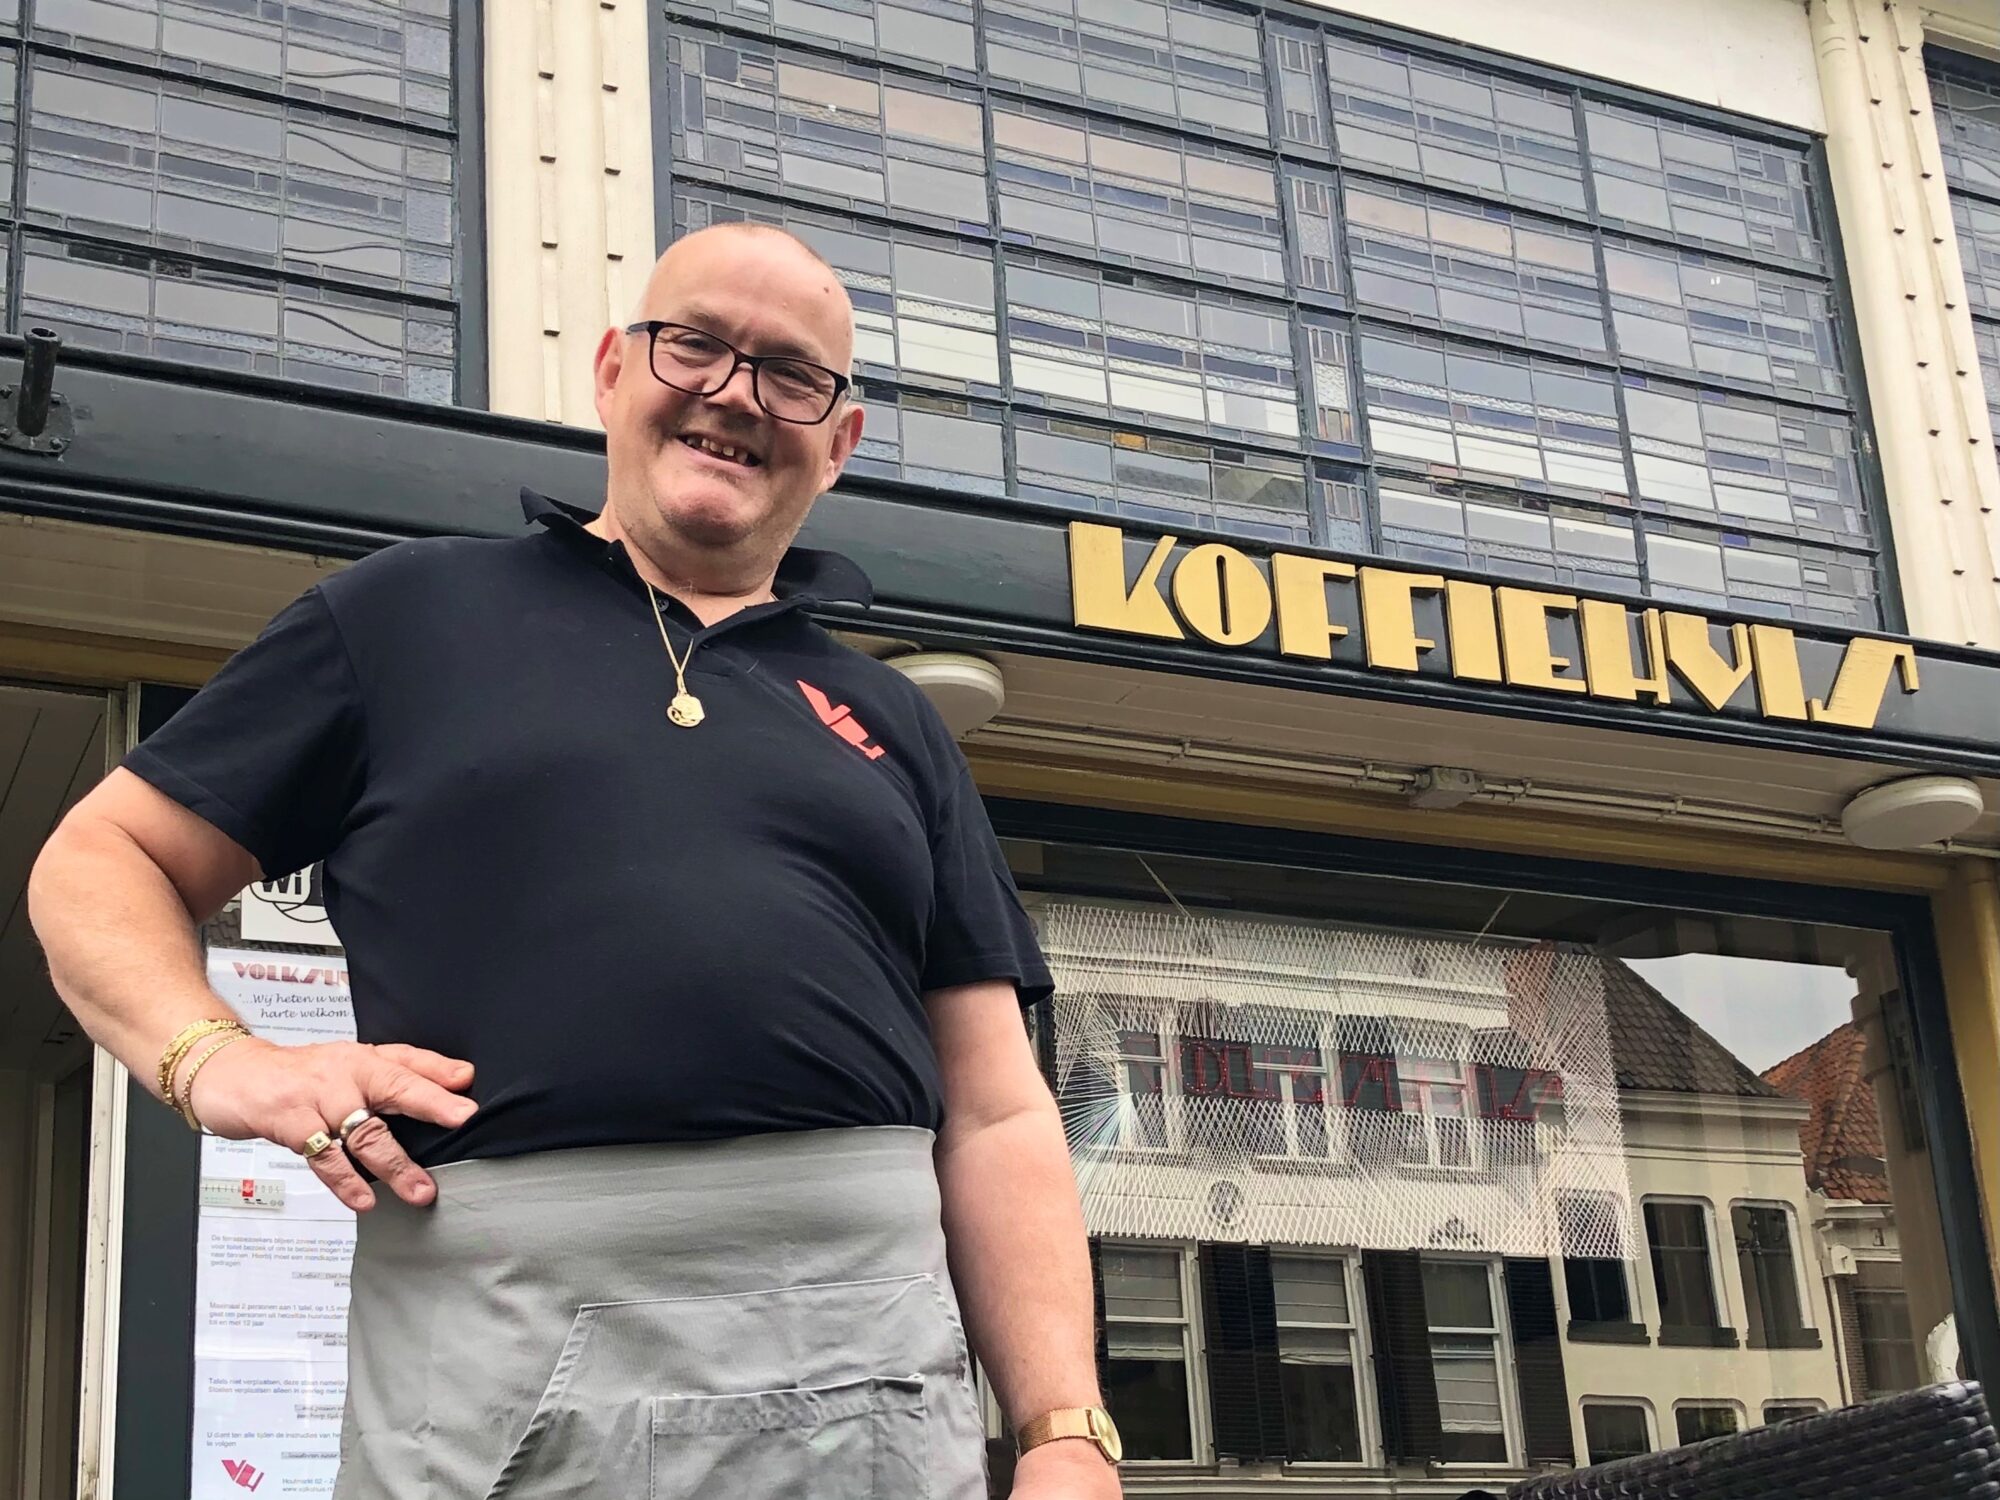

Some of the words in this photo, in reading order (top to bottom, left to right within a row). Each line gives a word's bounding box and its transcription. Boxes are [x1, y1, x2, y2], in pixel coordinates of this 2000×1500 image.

[1069, 521, 1919, 729] KOFFIEHUIS
[276, 993, 314, 1003] heten
[316, 995, 326, 1003] u
[260, 1008, 299, 1018] harte
[300, 1007, 349, 1018] welkom
